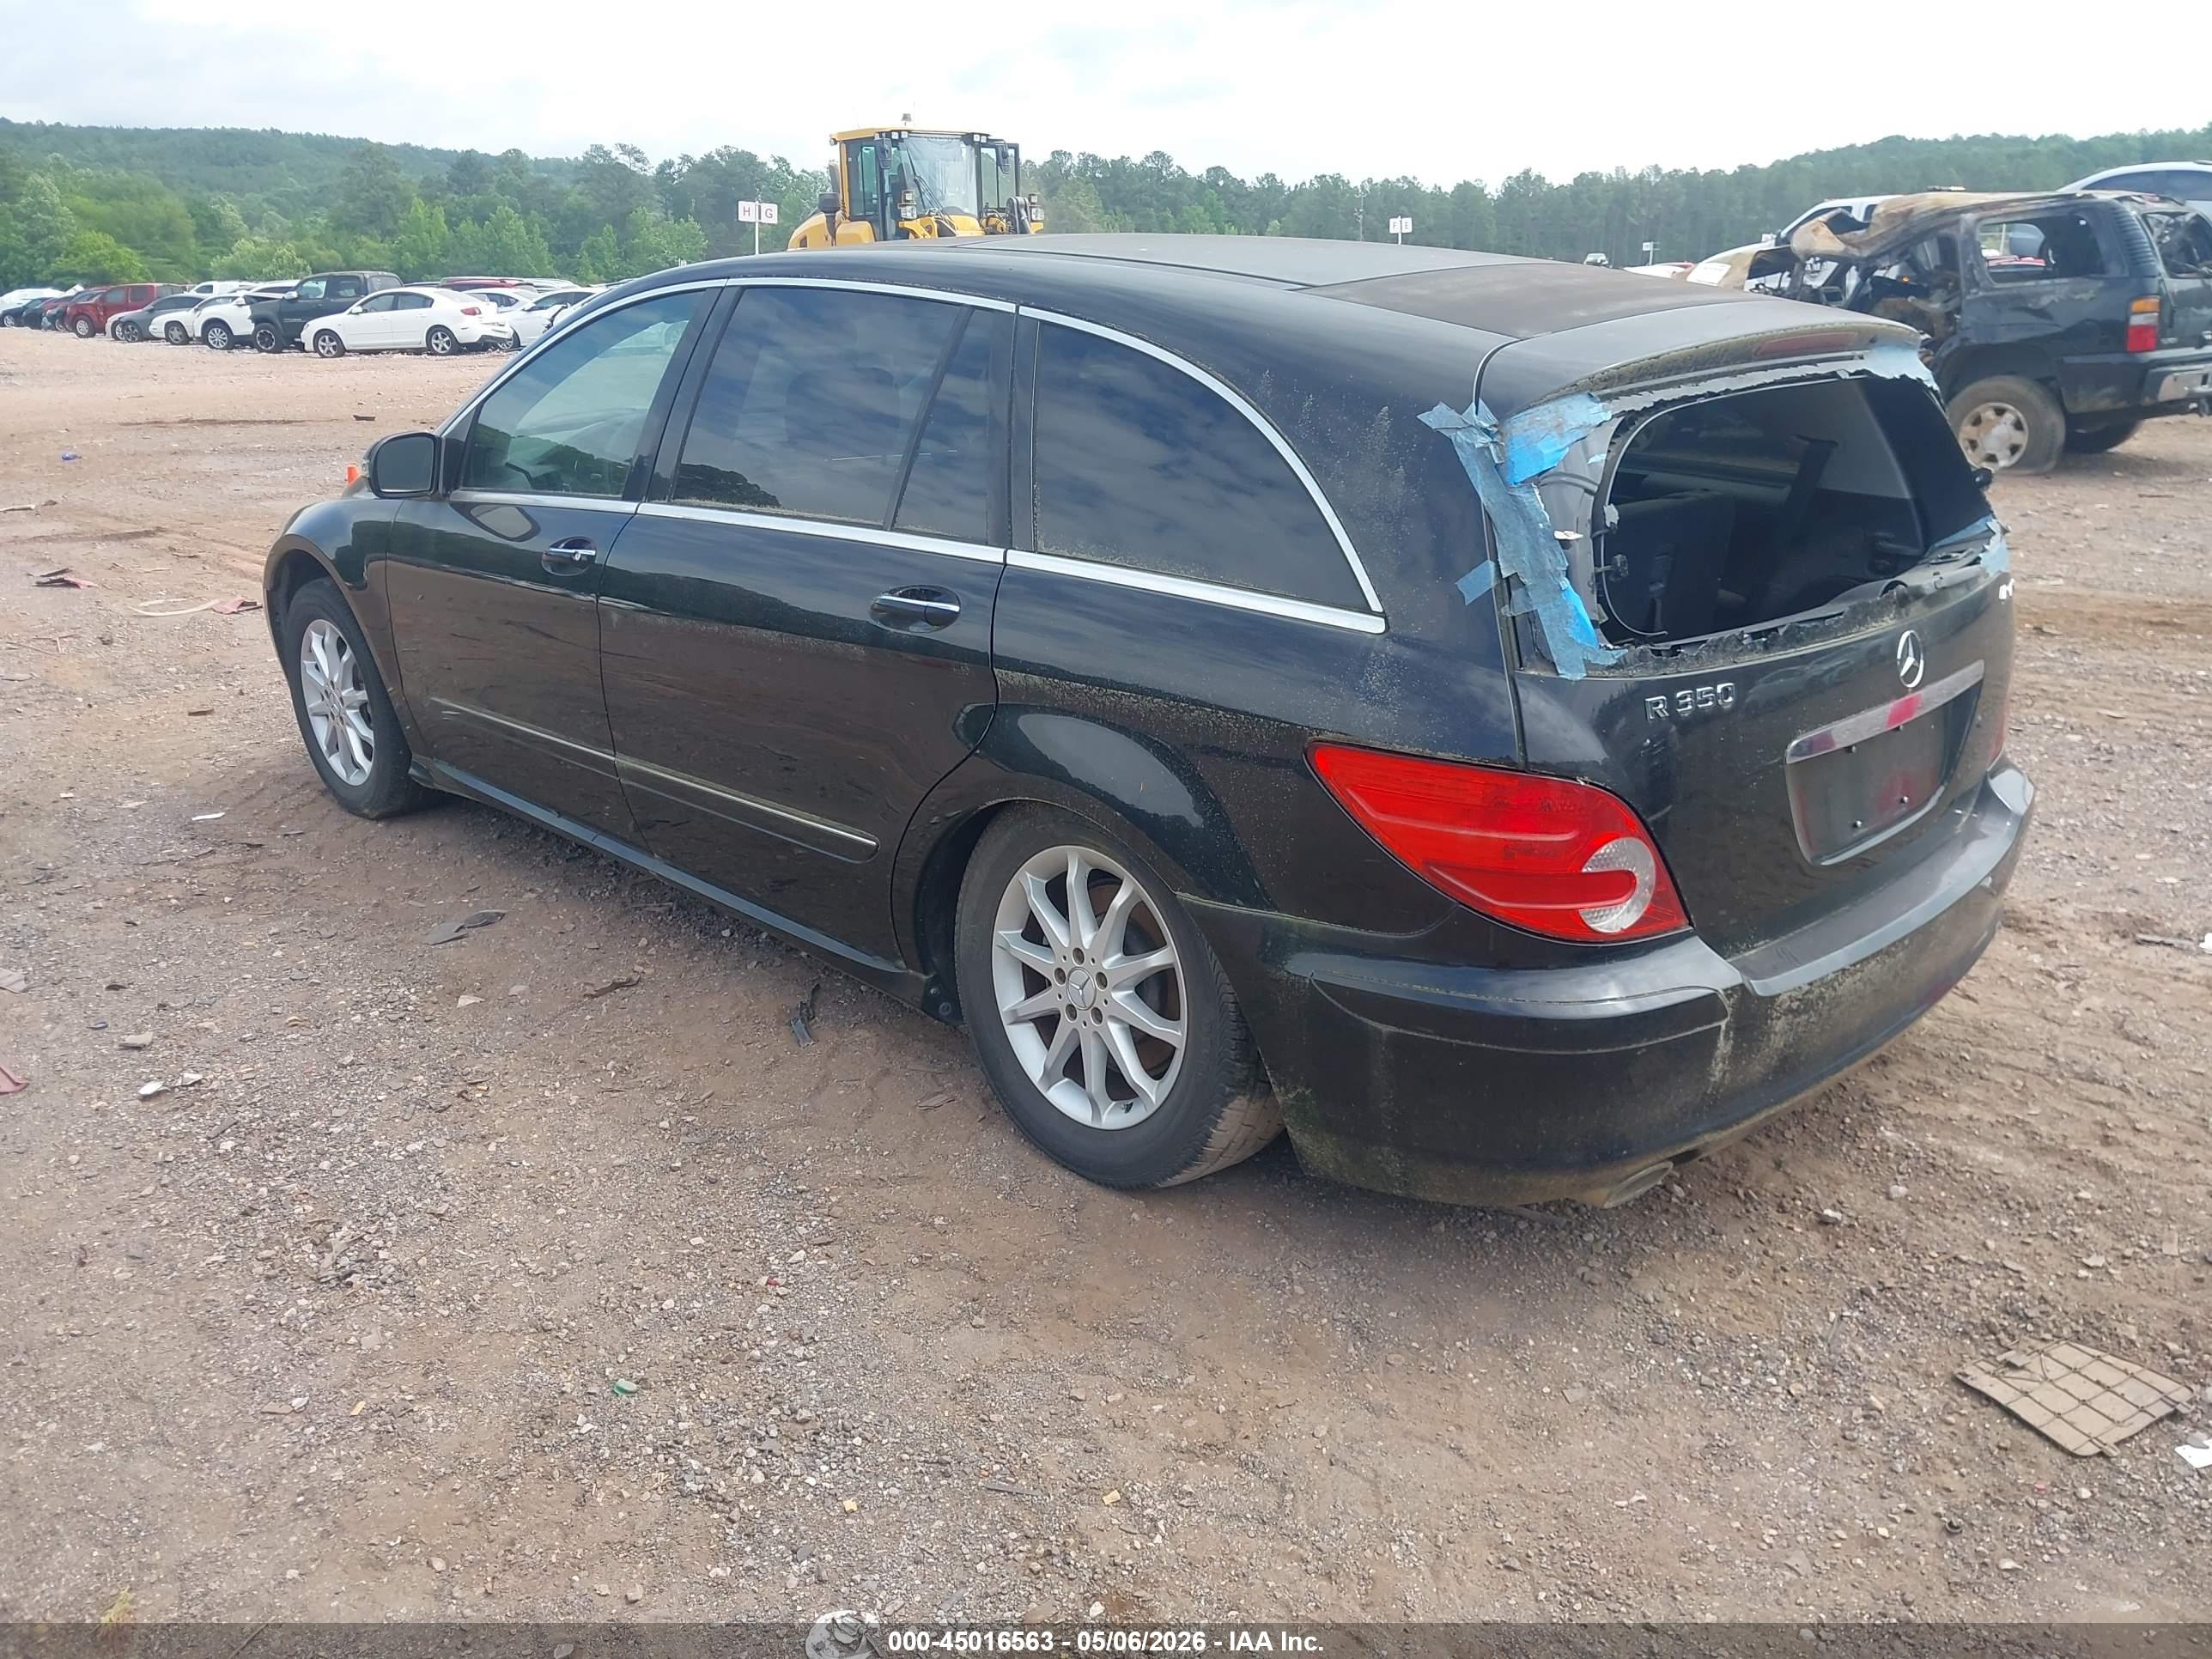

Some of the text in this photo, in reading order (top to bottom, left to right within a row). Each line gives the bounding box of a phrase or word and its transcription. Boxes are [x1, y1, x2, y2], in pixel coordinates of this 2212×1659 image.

[743, 206, 750, 216] H
[765, 208, 774, 219] G
[1645, 683, 1735, 720] R 350
